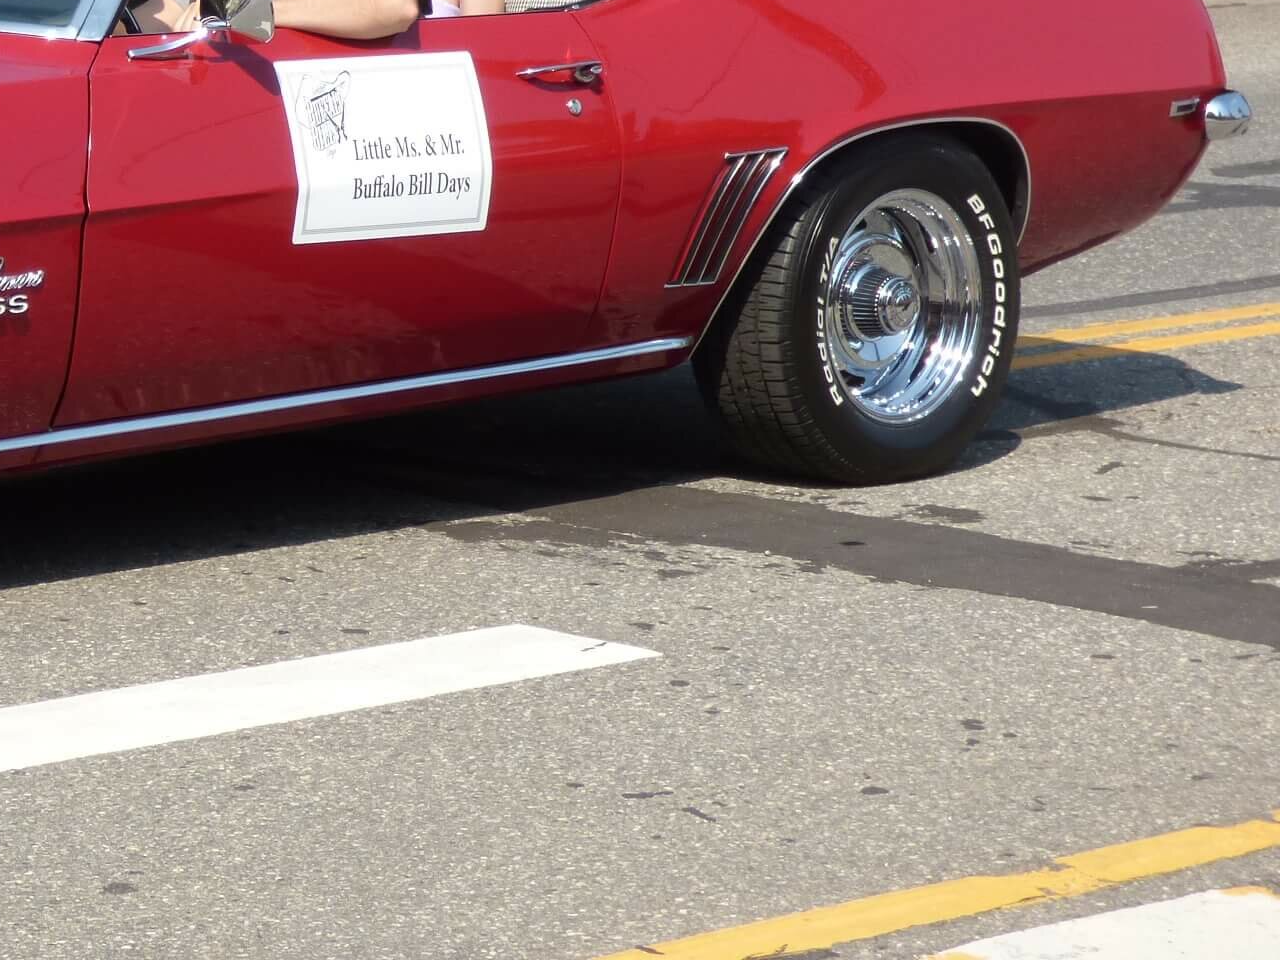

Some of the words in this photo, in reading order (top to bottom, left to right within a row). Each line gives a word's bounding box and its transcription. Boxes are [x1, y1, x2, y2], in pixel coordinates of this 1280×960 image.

[353, 136, 392, 161] Little
[395, 135, 422, 158] Ms.
[425, 133, 438, 156] &
[440, 132, 465, 156] Mr.
[353, 174, 405, 200] Buffalo
[408, 172, 433, 196] Bill
[437, 171, 471, 200] Days
[966, 193, 1007, 398] BFGoodrich
[816, 297, 844, 406] Radial
